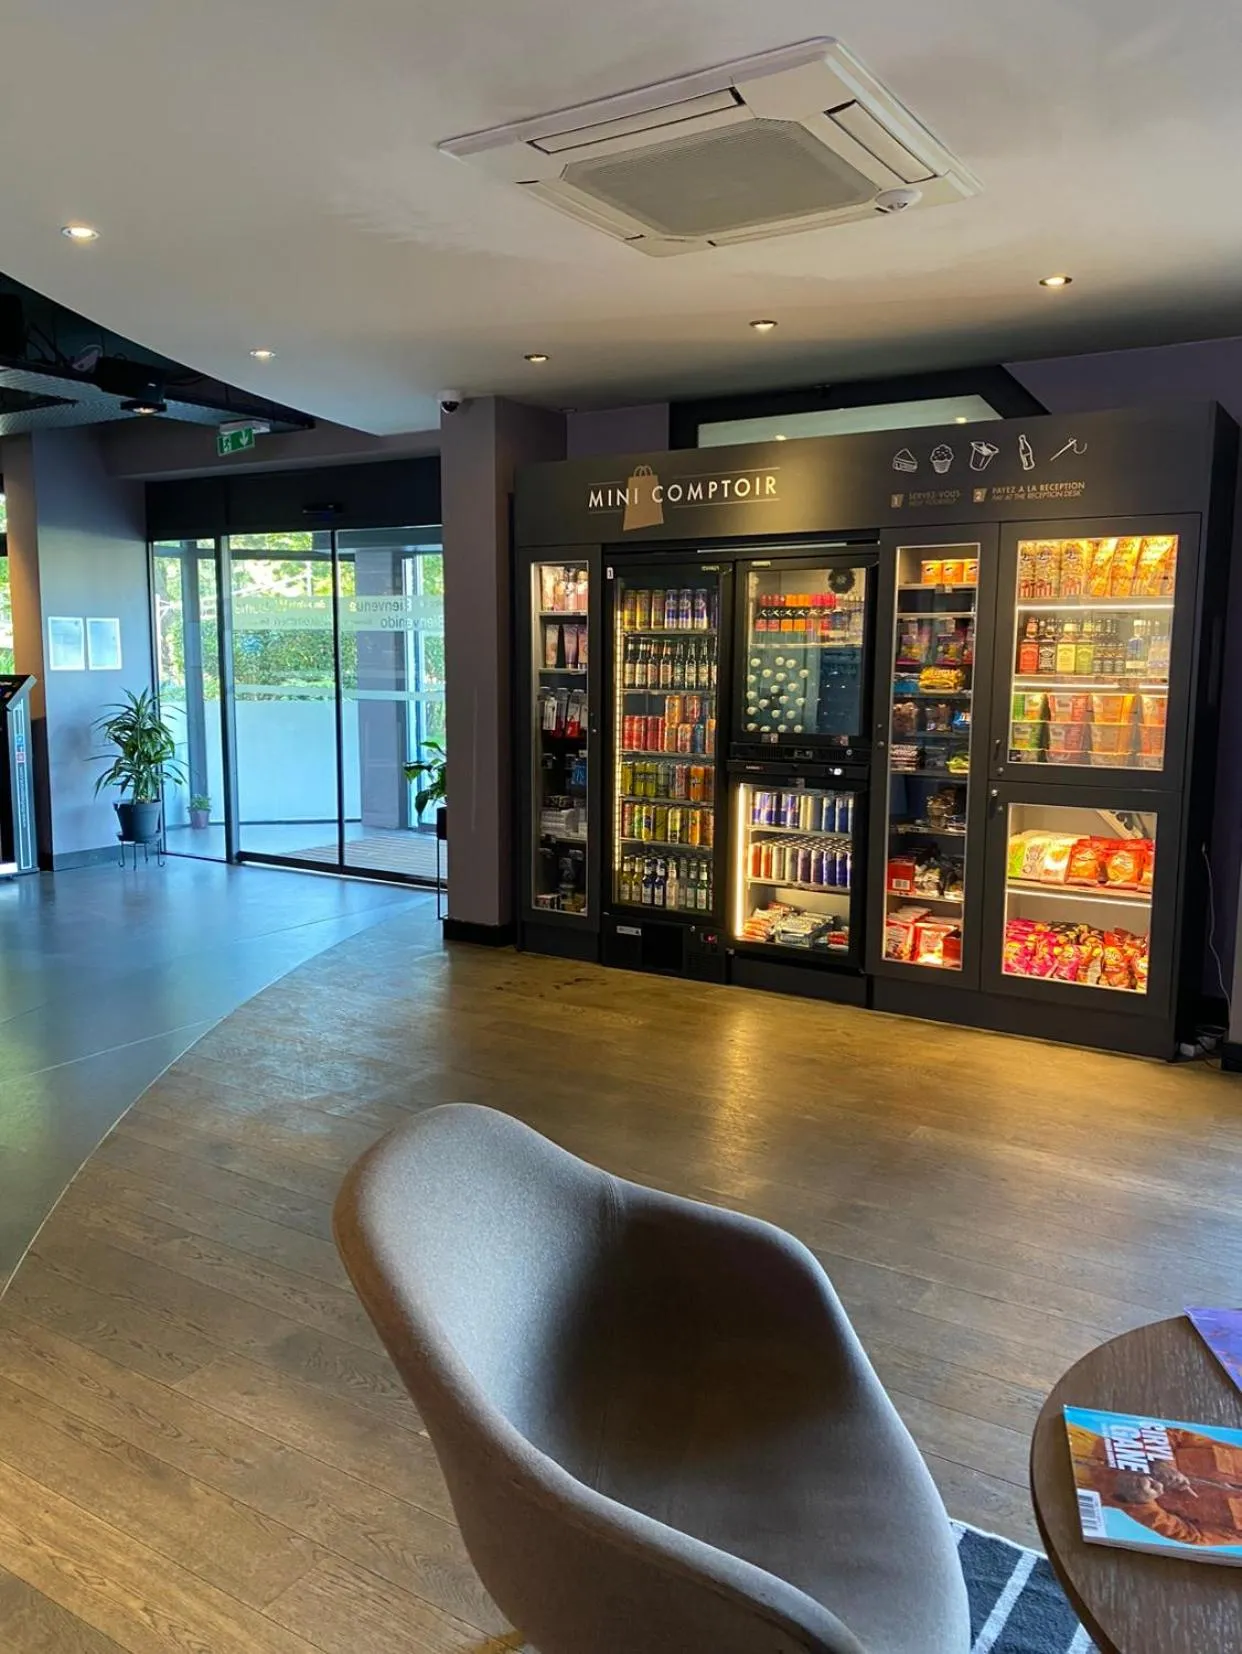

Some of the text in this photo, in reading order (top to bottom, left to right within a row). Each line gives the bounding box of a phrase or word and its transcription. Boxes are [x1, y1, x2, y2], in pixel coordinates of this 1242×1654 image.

[588, 476, 777, 508] MINI COMPTOIR
[1027, 484, 1037, 493] LA
[1109, 1424, 1151, 1474] GANE
